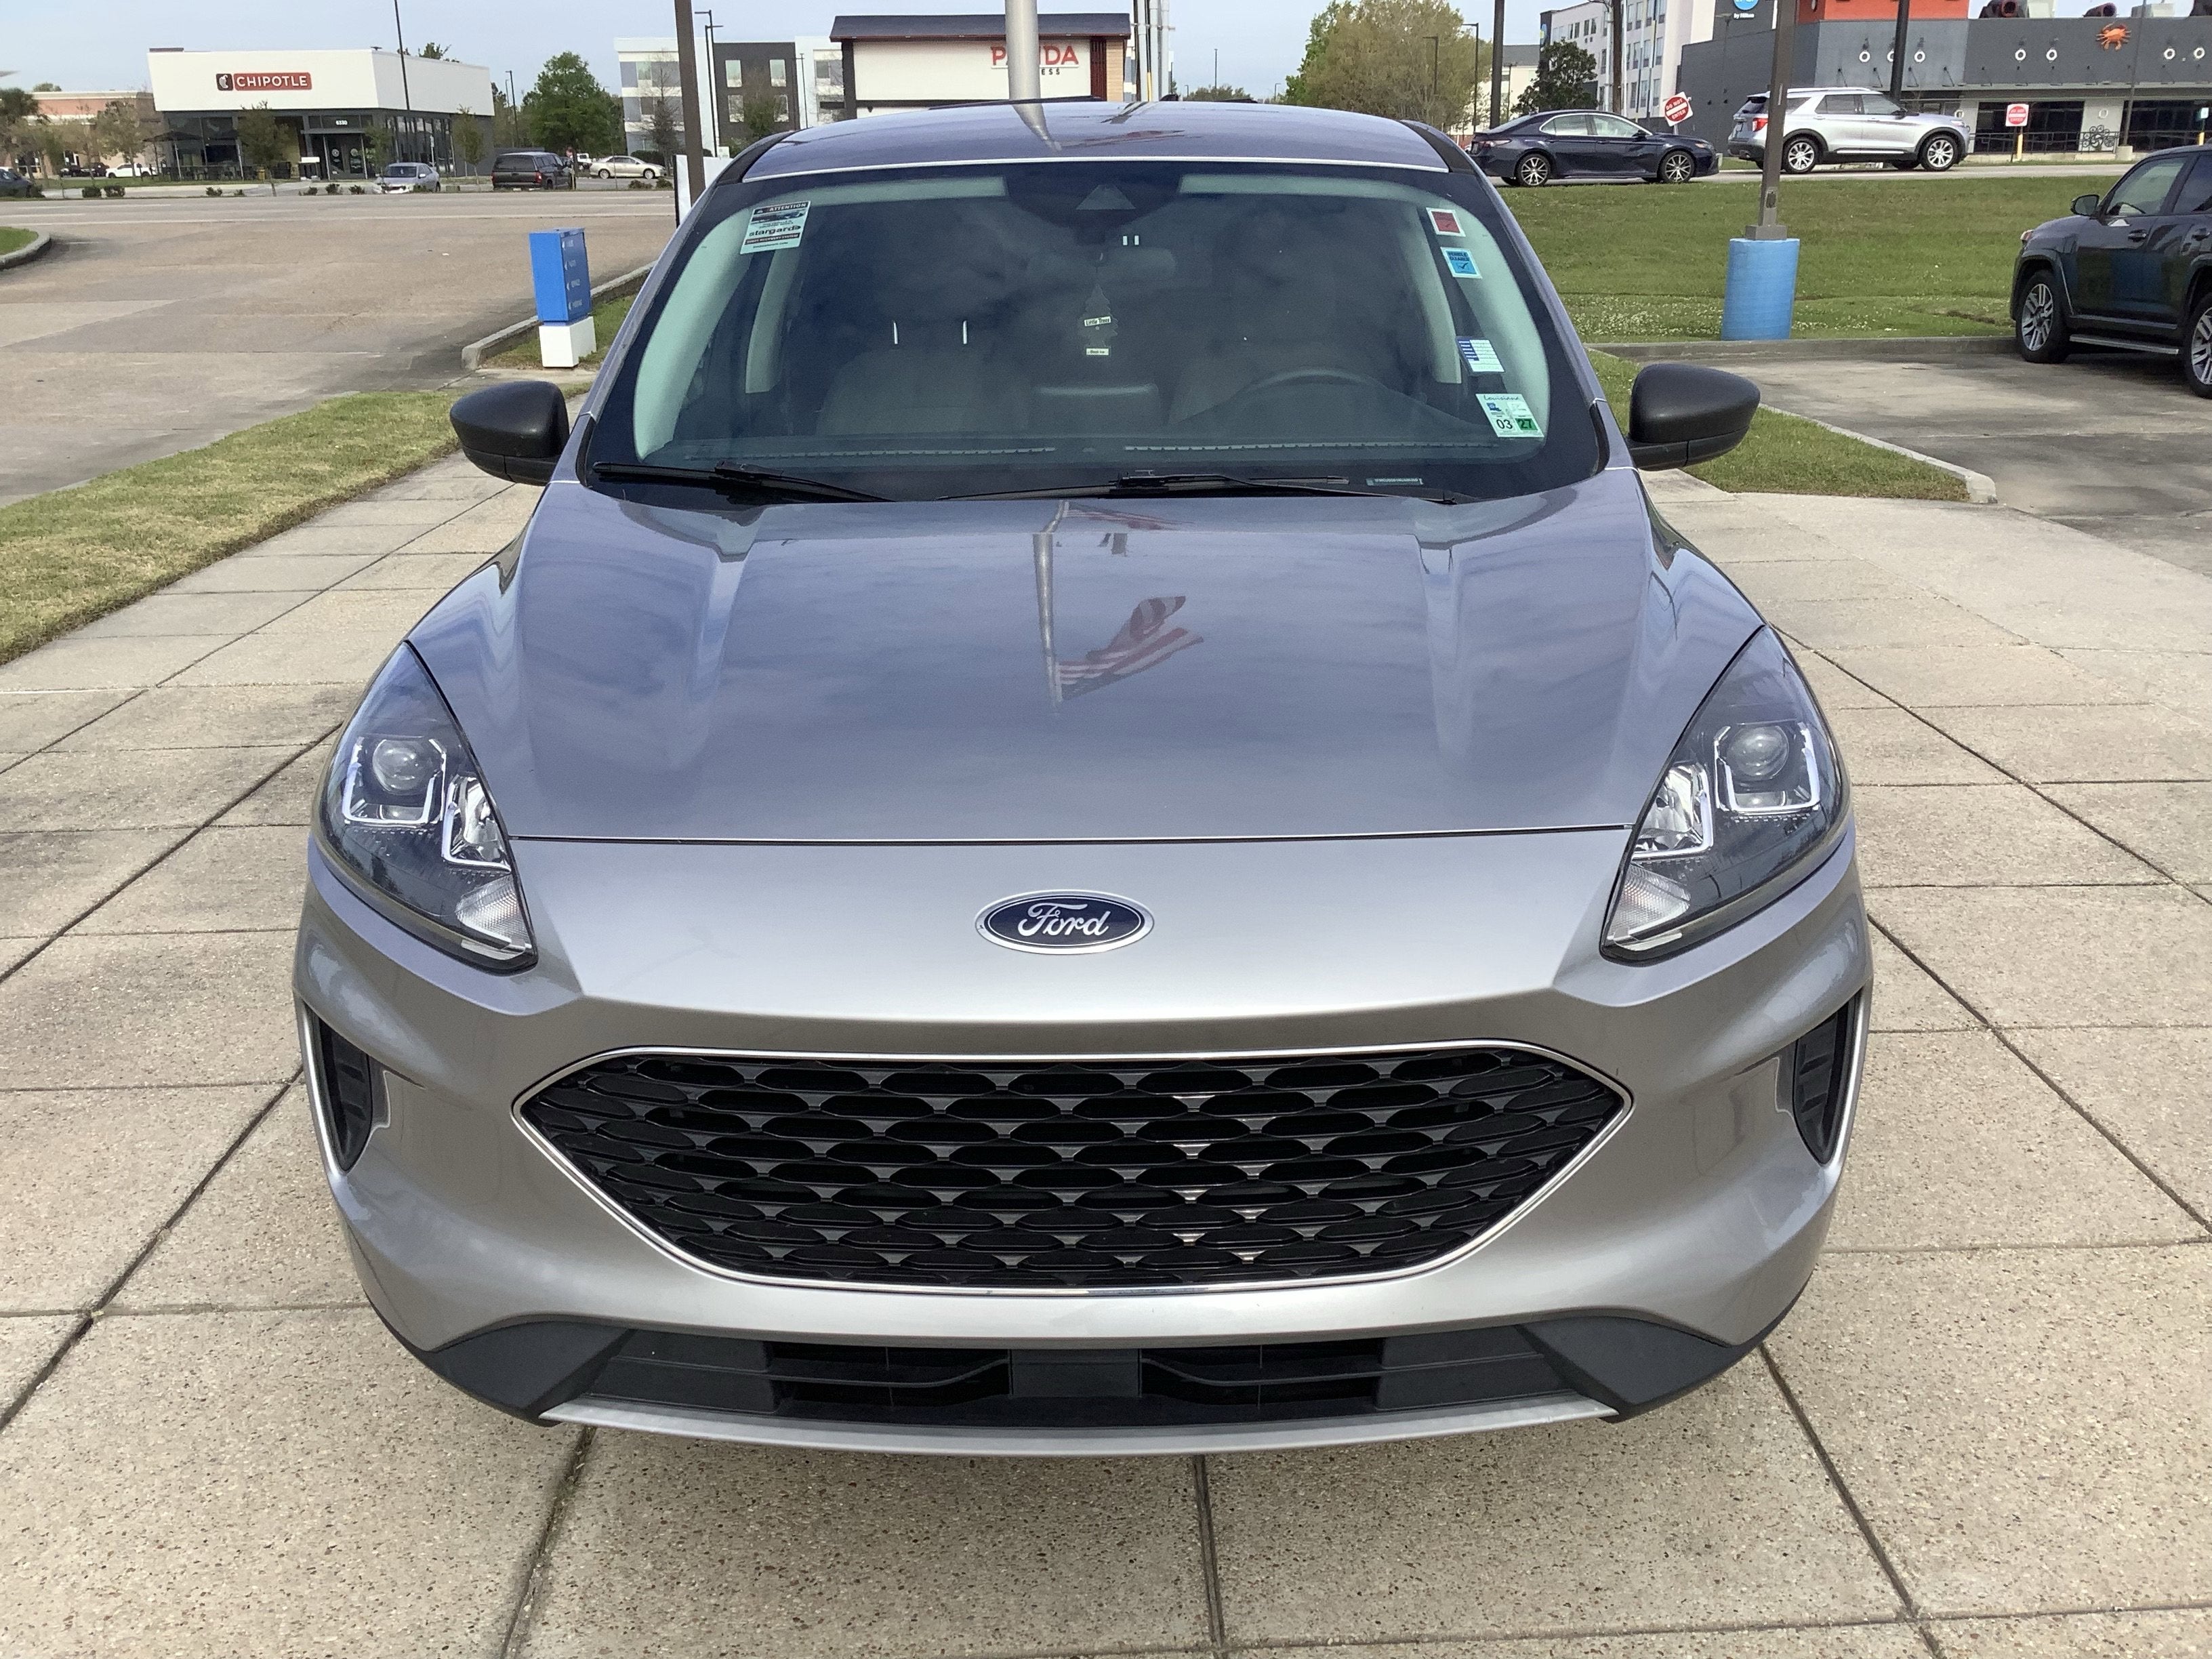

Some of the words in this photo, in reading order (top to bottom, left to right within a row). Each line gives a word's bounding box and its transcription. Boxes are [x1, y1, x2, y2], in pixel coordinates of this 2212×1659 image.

[990, 45, 1079, 66] PDA
[237, 75, 308, 87] CHIPOTLE
[769, 203, 806, 211] ATTENTION
[1496, 419, 1513, 430] 03
[1517, 418, 1533, 429] 27
[1017, 902, 1111, 937] Ford
